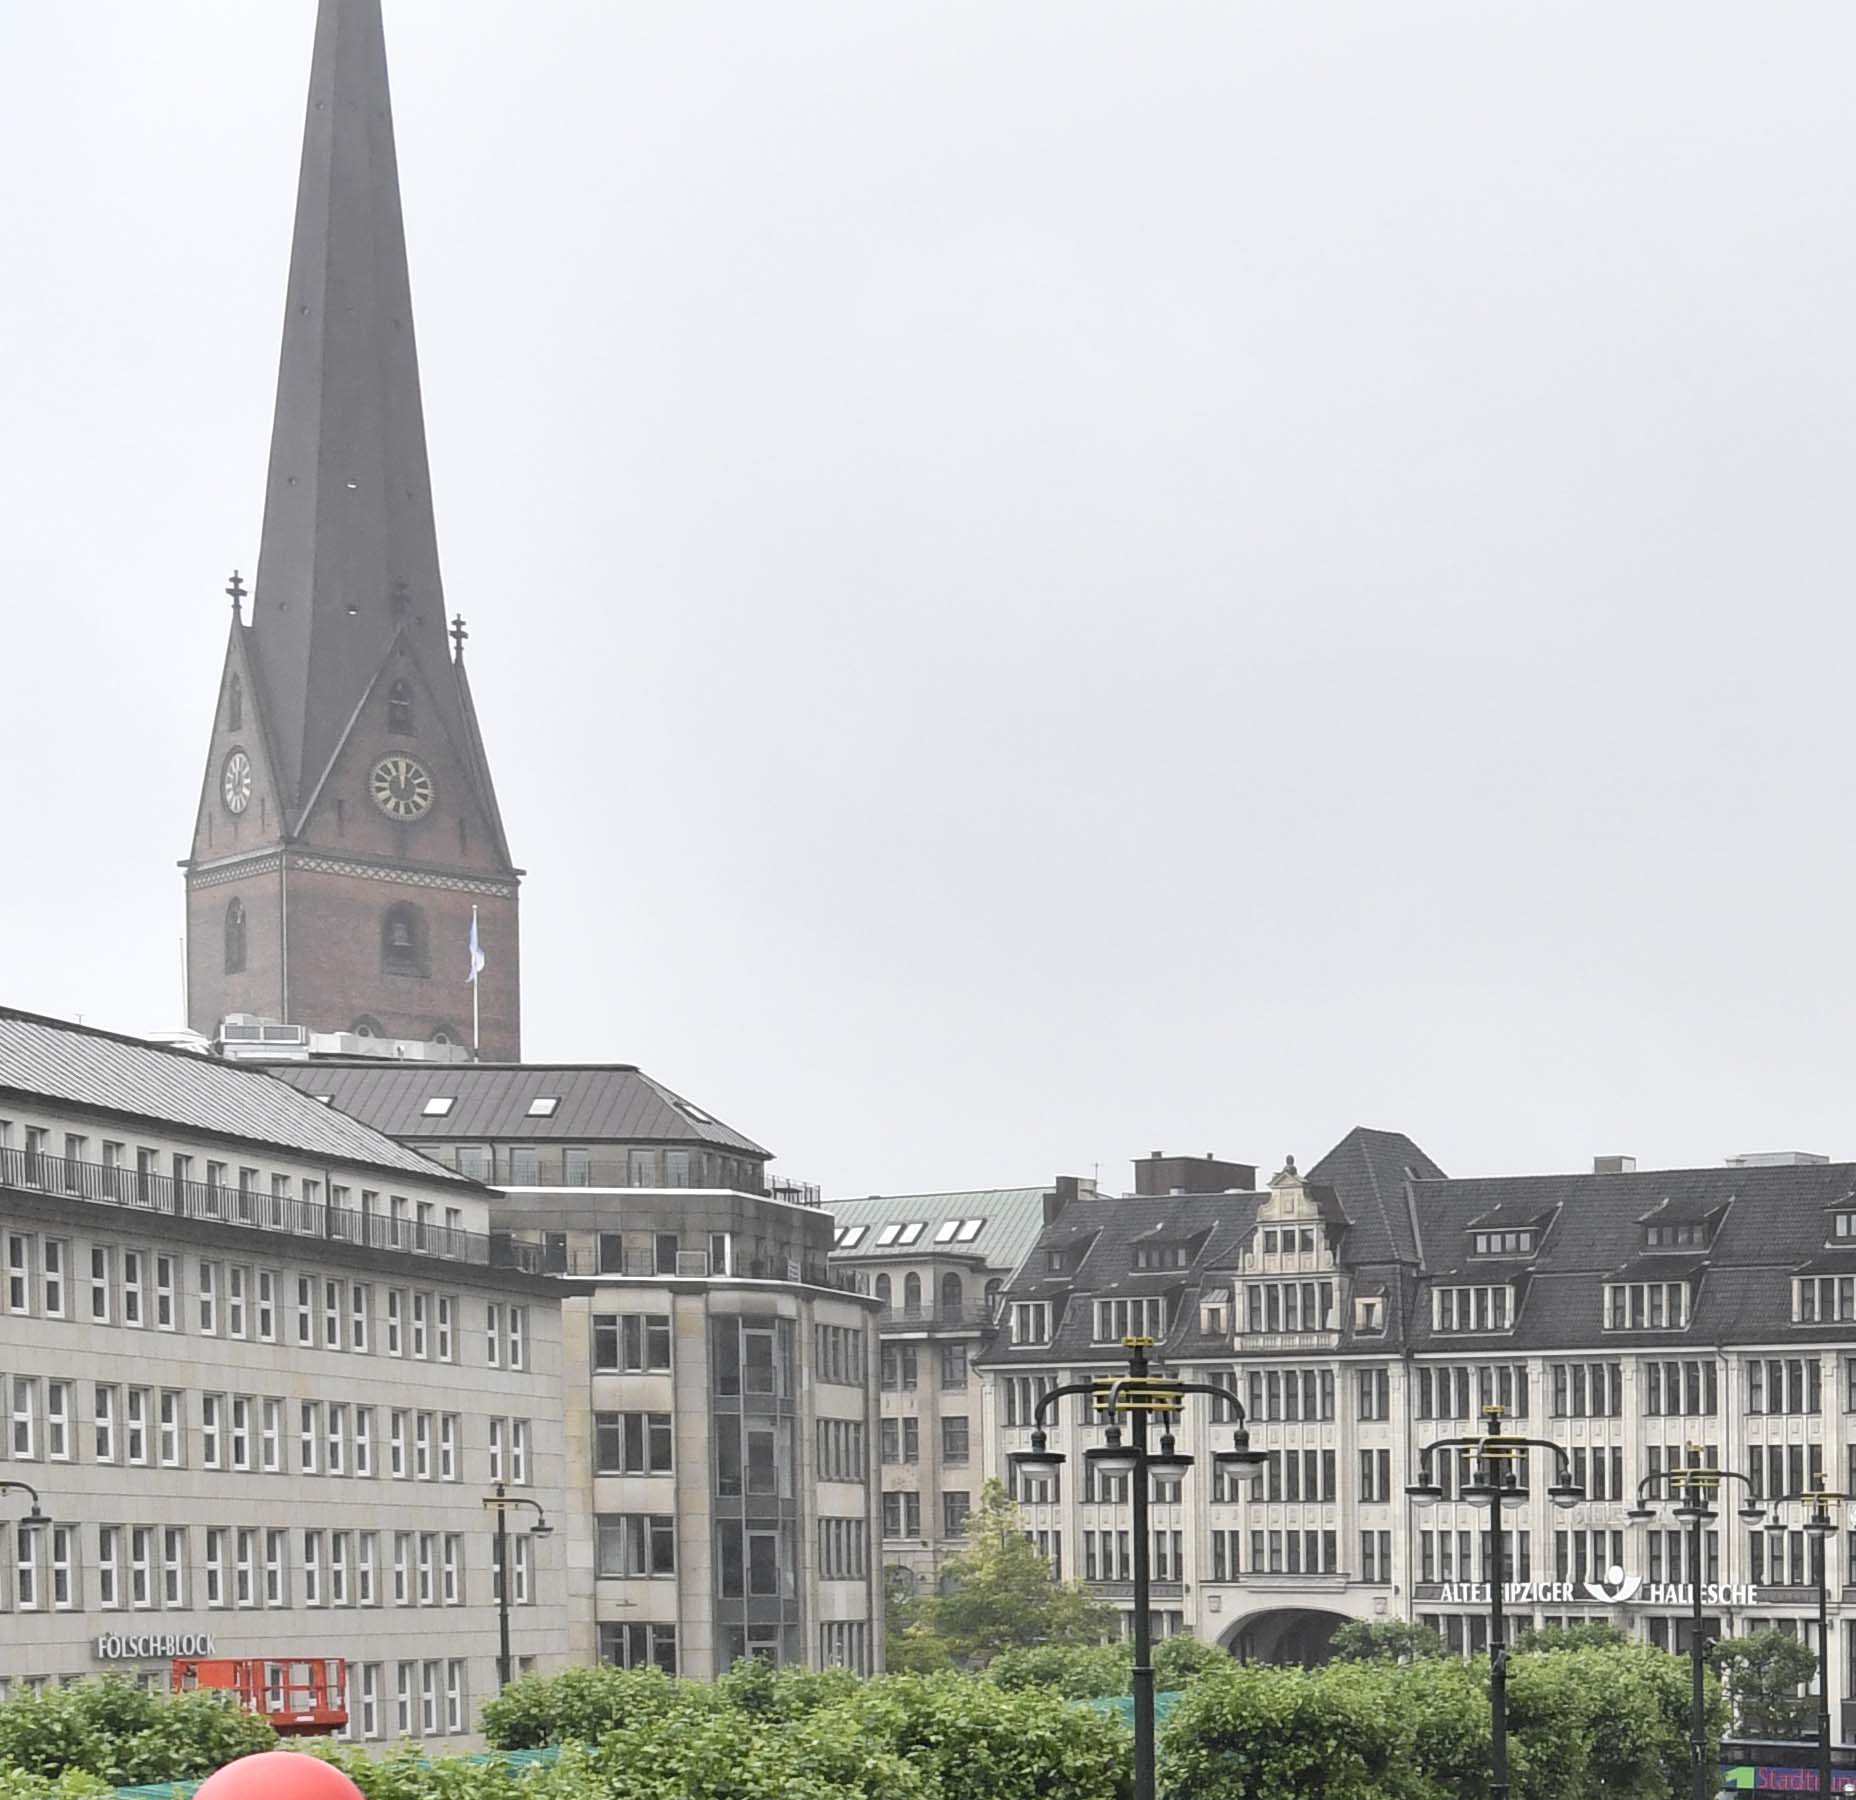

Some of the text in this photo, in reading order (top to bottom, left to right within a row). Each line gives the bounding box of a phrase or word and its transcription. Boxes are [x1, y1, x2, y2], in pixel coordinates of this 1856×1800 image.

[1440, 1583, 1574, 1602] ALTE LIPZIGER
[99, 1632, 216, 1659] FÖLSCH-BLOCK
